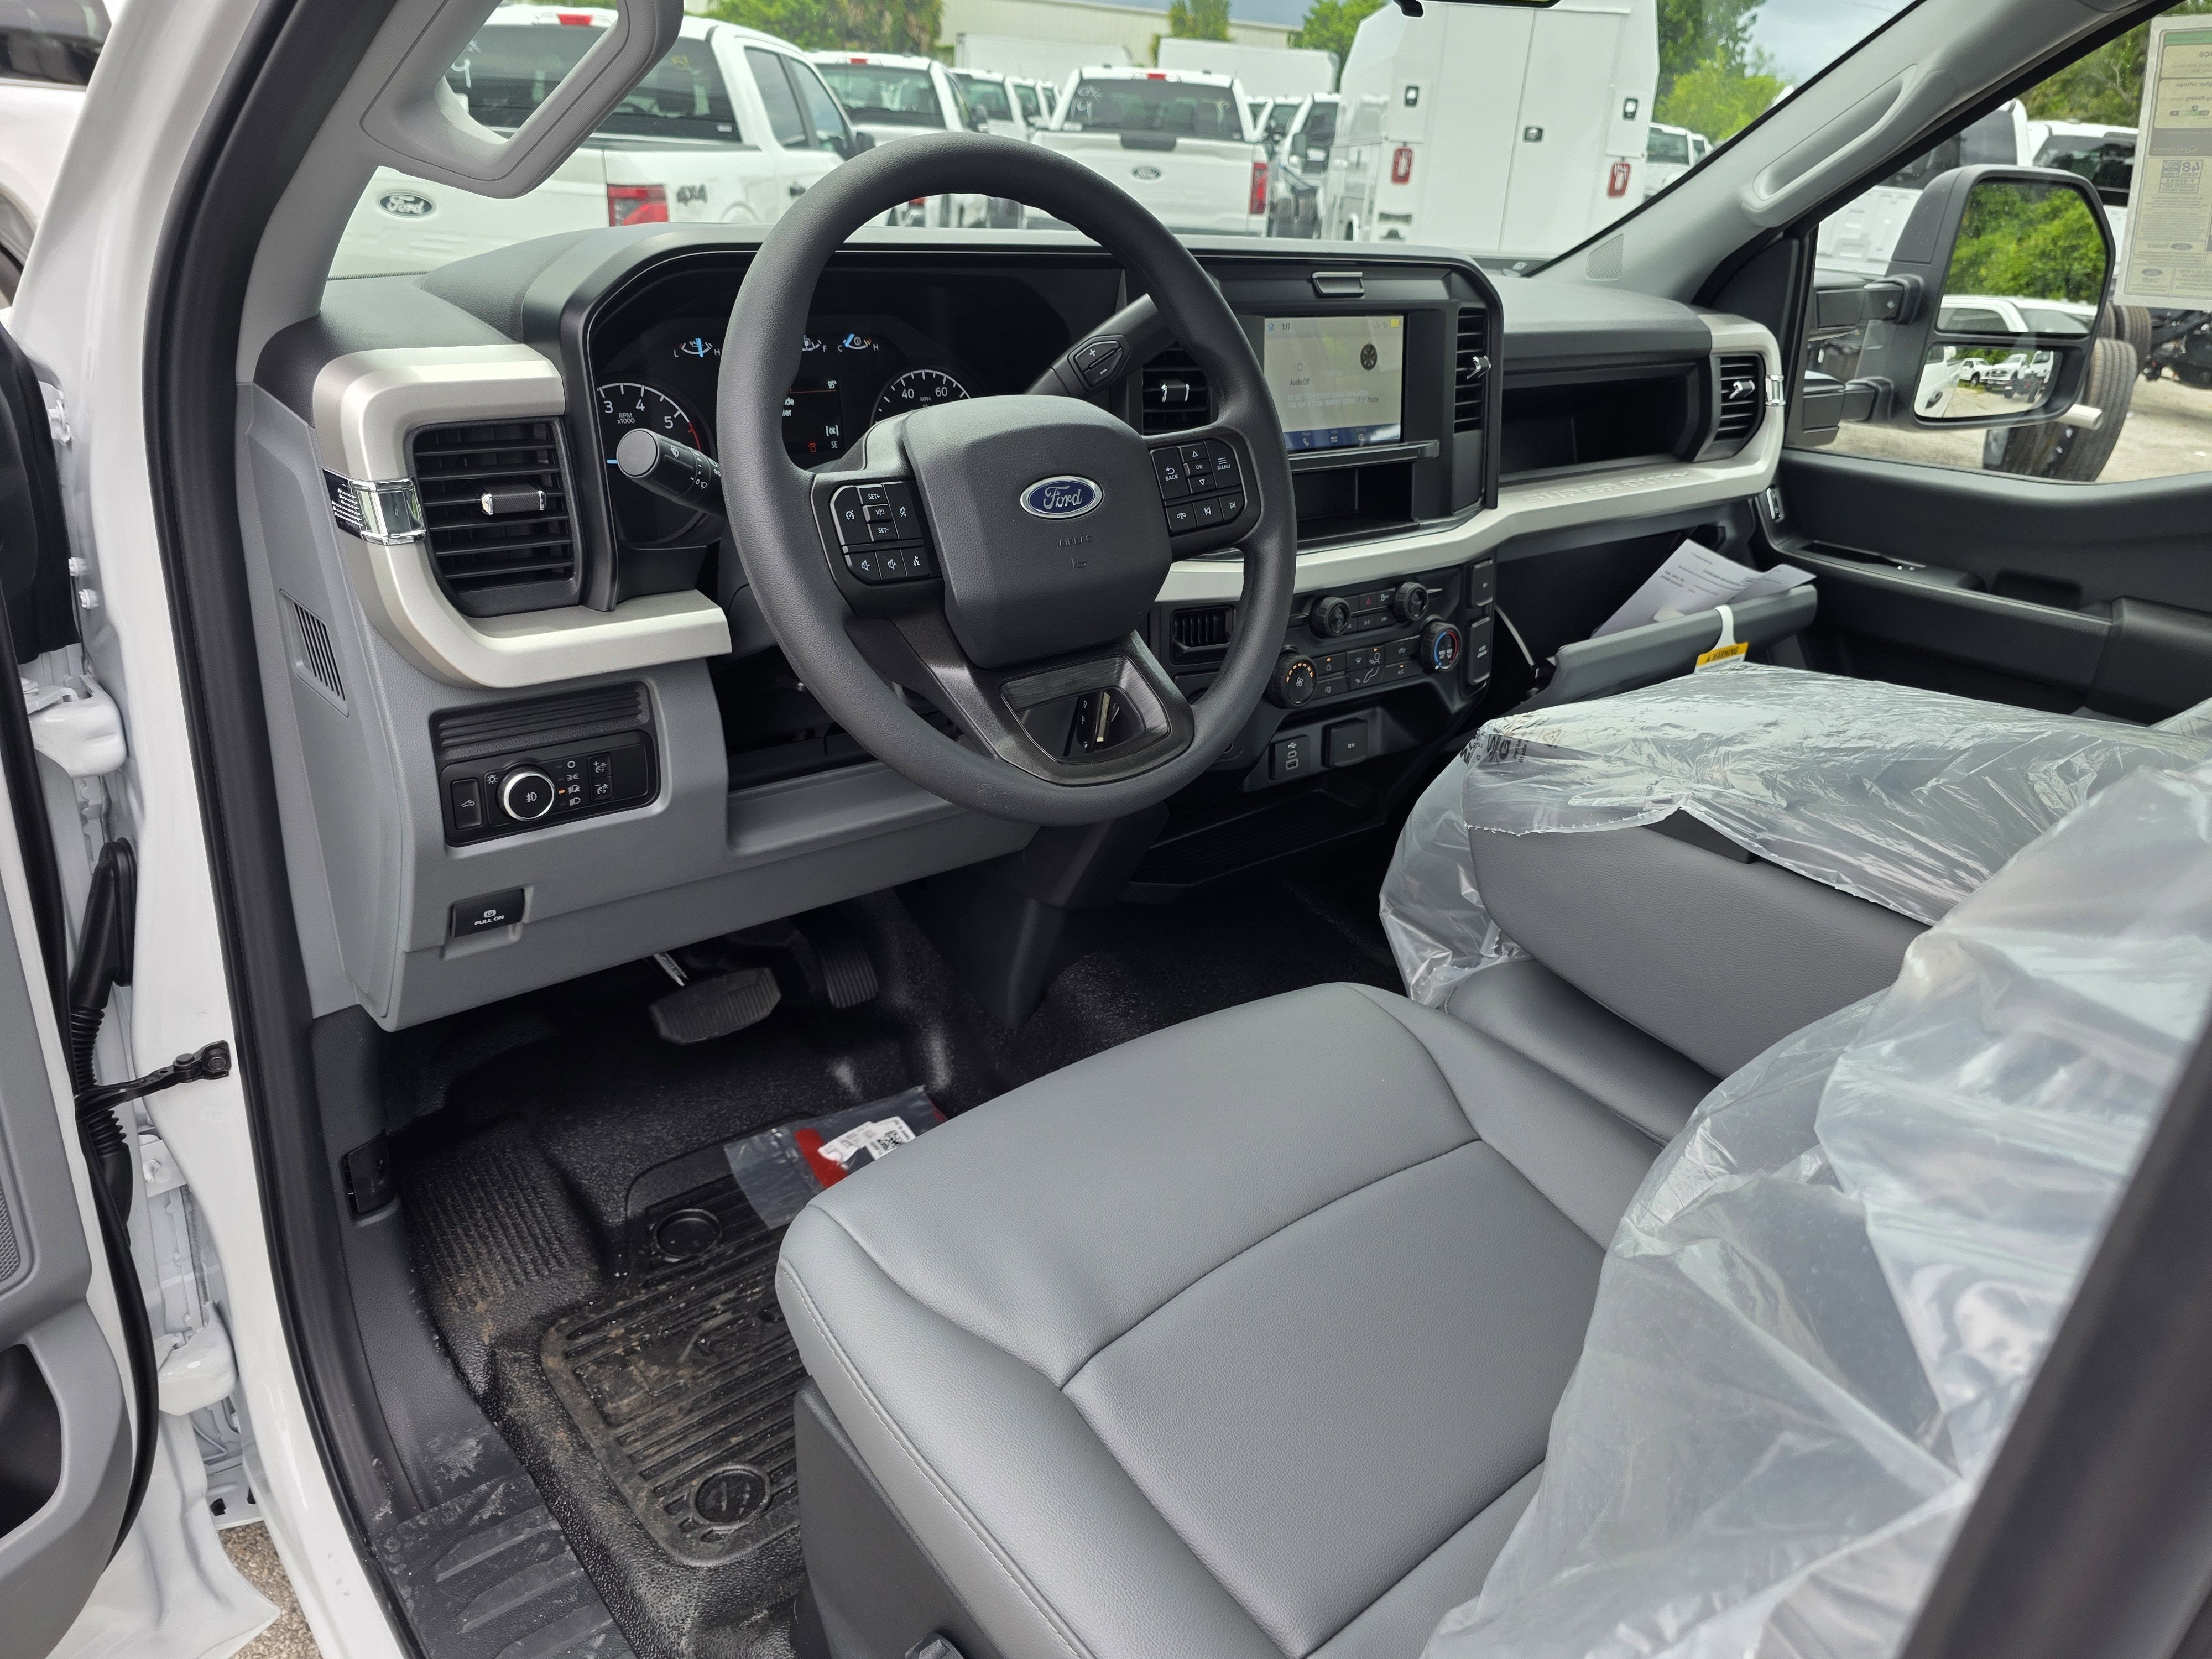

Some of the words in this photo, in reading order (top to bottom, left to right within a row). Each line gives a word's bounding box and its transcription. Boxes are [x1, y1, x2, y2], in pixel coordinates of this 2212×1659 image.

[386, 195, 425, 214] Ford
[837, 344, 843, 352] C
[902, 388, 915, 399] 40
[935, 387, 948, 397] 60
[604, 400, 613, 413] 3
[636, 399, 645, 411] 4
[664, 416, 674, 429] 5
[1043, 485, 1083, 509] Ford
[1058, 535, 1093, 548] AIRBAG
[1713, 646, 1738, 661] WARNING
